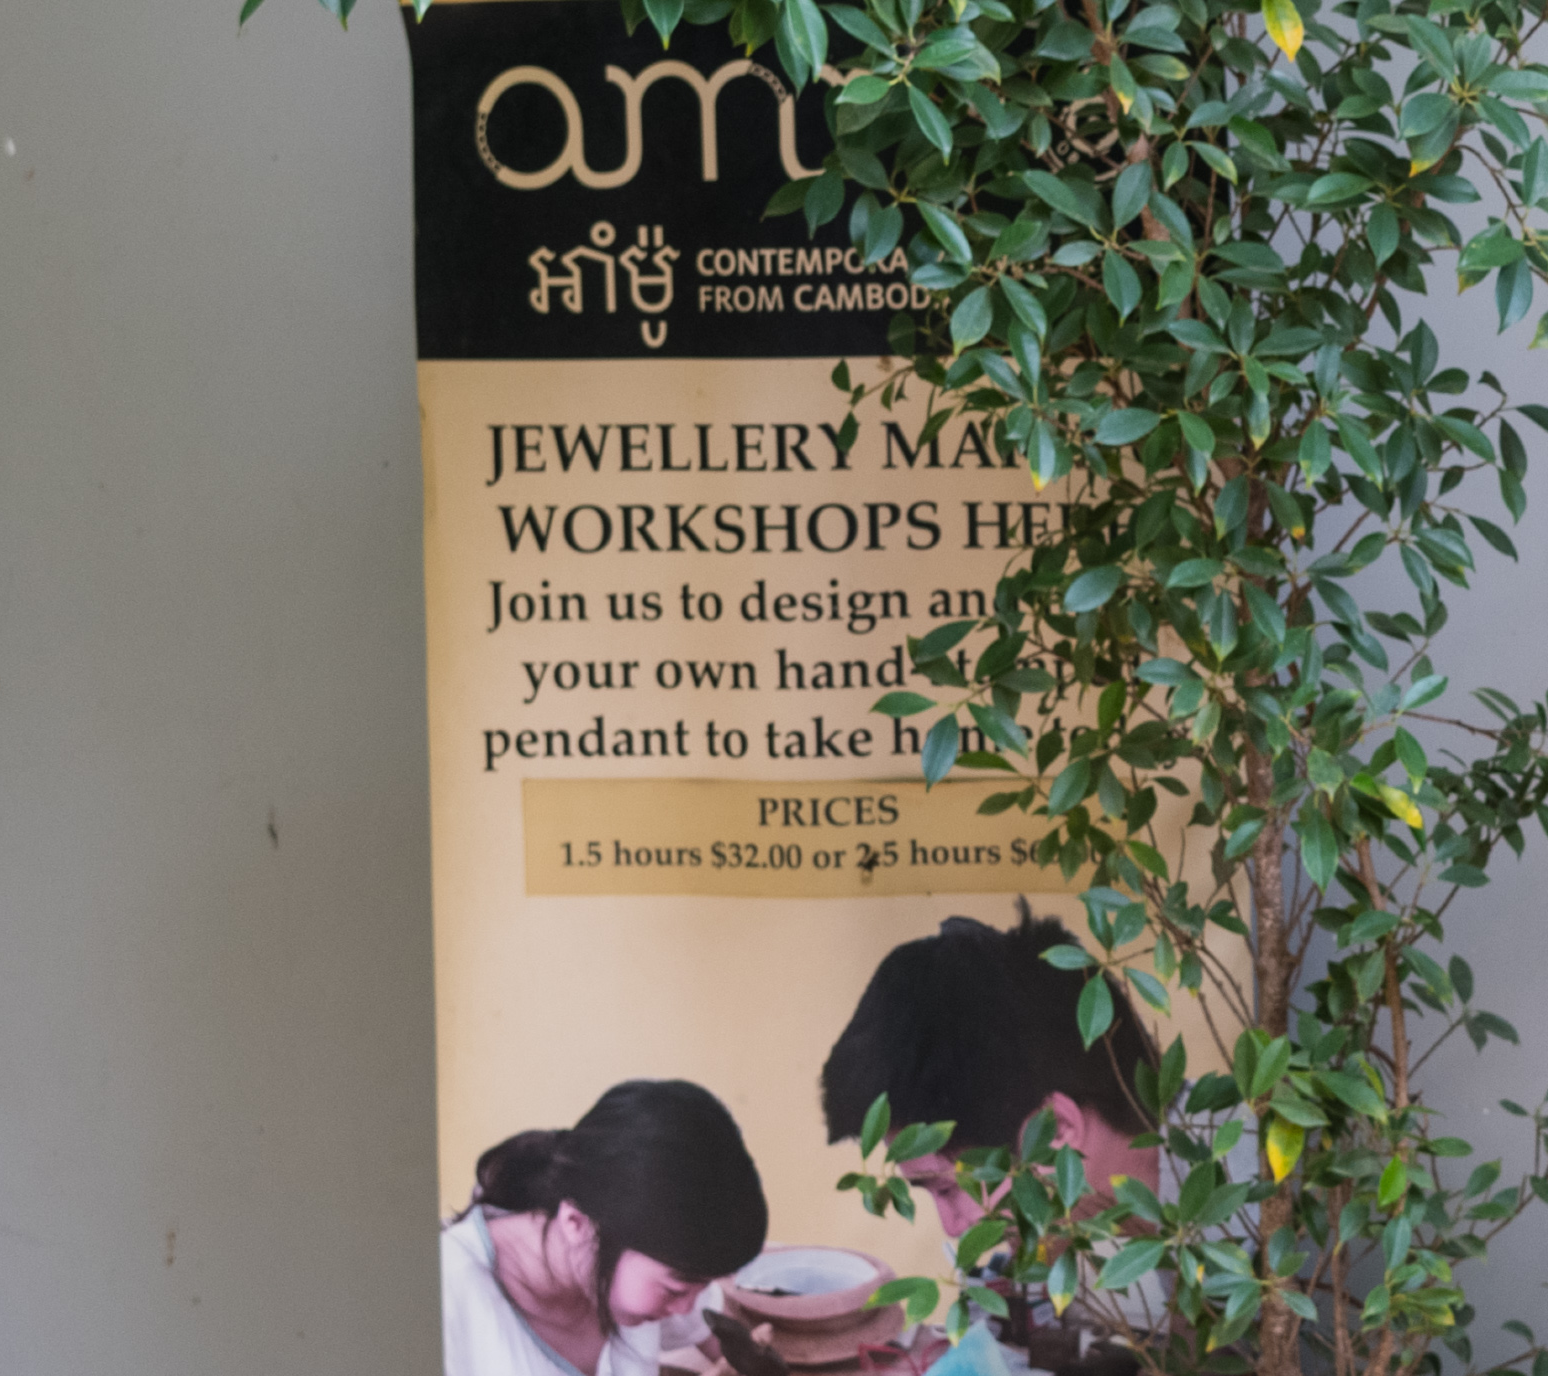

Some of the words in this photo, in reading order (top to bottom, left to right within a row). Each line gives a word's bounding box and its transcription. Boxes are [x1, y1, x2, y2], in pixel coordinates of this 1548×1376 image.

[698, 284, 785, 313] FROM
[792, 282, 951, 312] CAMBOD
[485, 421, 860, 488] JEWELLERY
[496, 500, 943, 554] WORKSHOPS
[487, 580, 588, 634] Join
[606, 592, 664, 622] us
[680, 583, 724, 622] to
[740, 578, 912, 635] design
[928, 580, 1022, 619] an
[521, 658, 640, 705] your
[656, 658, 759, 690] own
[482, 715, 691, 772] pendant
[706, 720, 749, 759] to
[766, 715, 874, 759] take
[757, 794, 900, 828] PRICES
[561, 841, 603, 868] 1.5
[613, 840, 703, 868] hours
[710, 840, 803, 870] $32.00
[812, 847, 847, 870] or
[855, 839, 900, 870] 25
[909, 838, 1002, 867] hours
